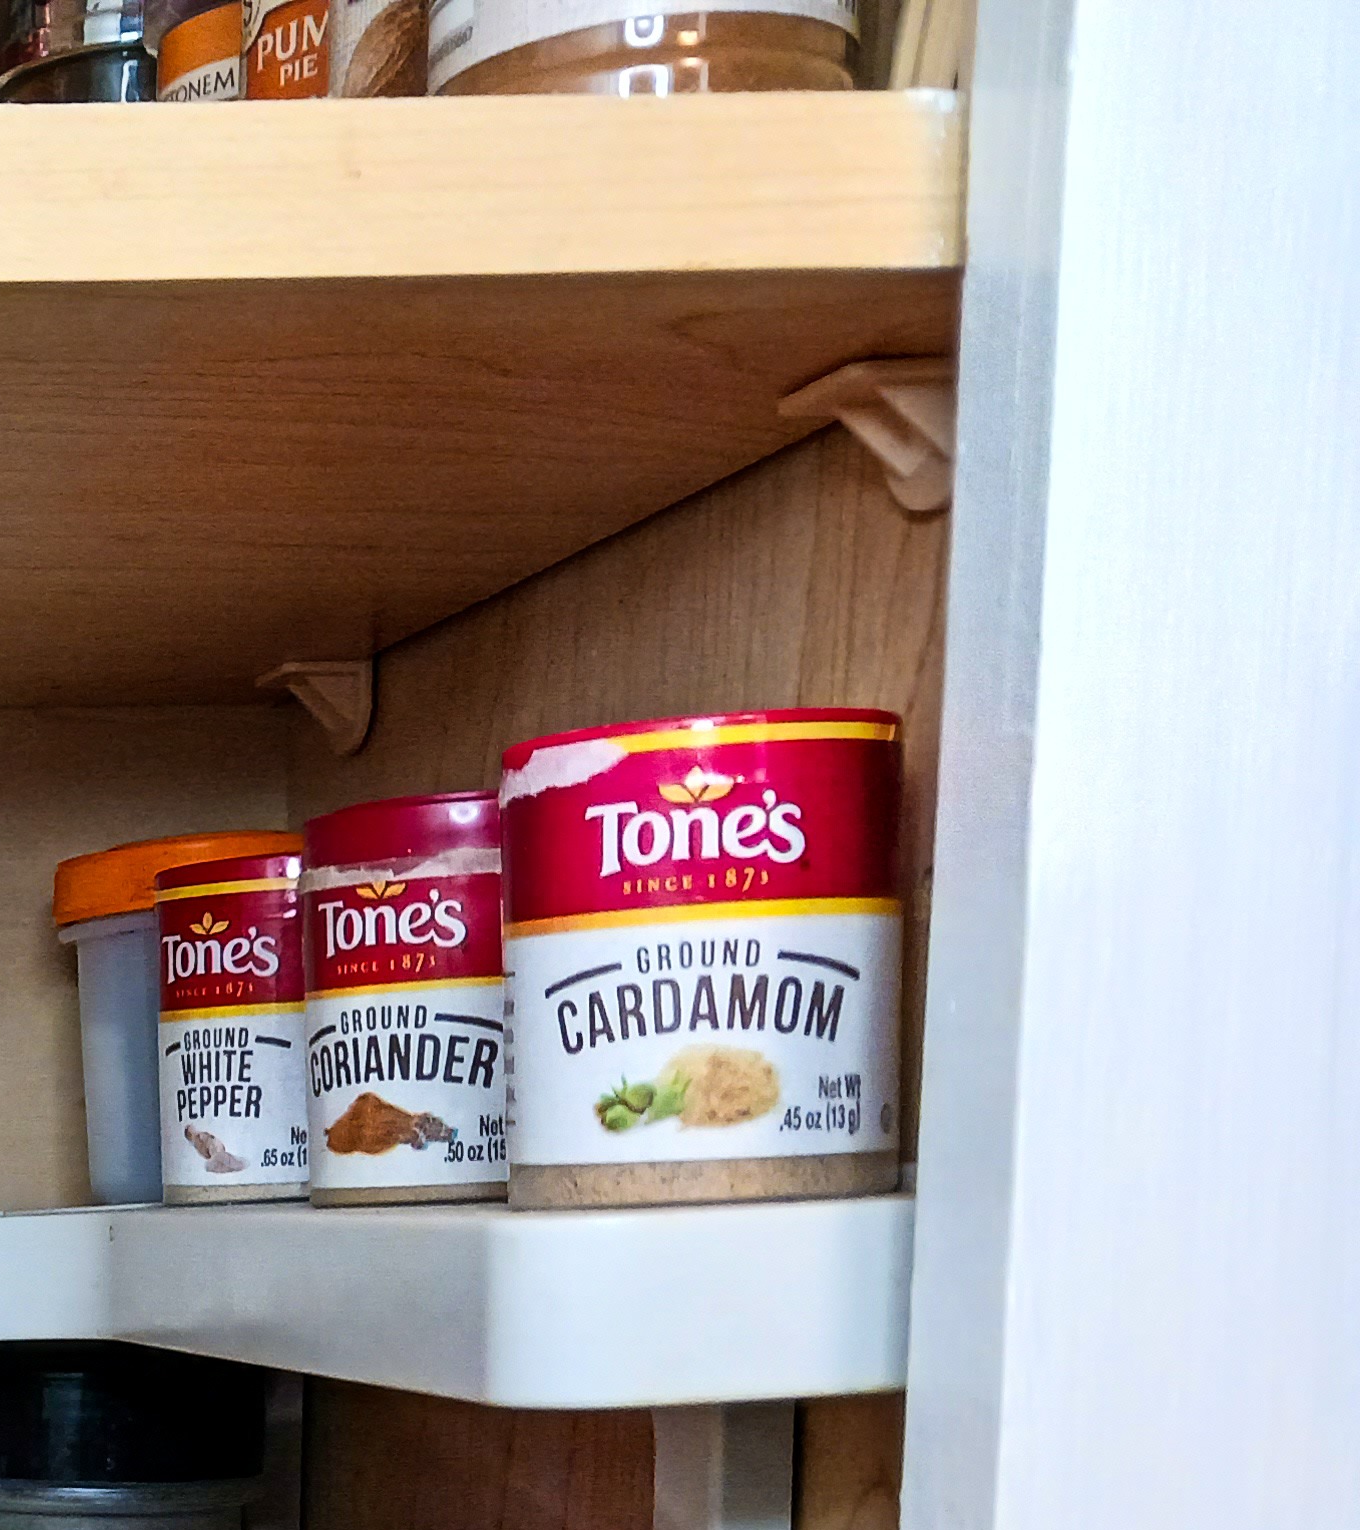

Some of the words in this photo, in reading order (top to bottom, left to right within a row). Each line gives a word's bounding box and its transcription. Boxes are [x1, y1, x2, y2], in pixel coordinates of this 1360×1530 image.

[280, 53, 319, 87] PIE
[584, 788, 806, 880] Tone's
[623, 874, 693, 896] SINCE
[318, 887, 467, 960] Tone's
[161, 926, 279, 985] Tone's
[636, 938, 762, 974] GROUND
[341, 1004, 428, 1034] GROUND
[556, 973, 845, 1056] CARDAMOM
[184, 1026, 250, 1052] GROUND
[181, 1050, 254, 1087] WHITE
[310, 1033, 499, 1099] CORIANDER
[176, 1084, 263, 1122] PEPPER
[818, 1074, 843, 1100] Net
[806, 1109, 823, 1132] oz
[280, 1151, 295, 1168] oz
[467, 1144, 485, 1163] oz
